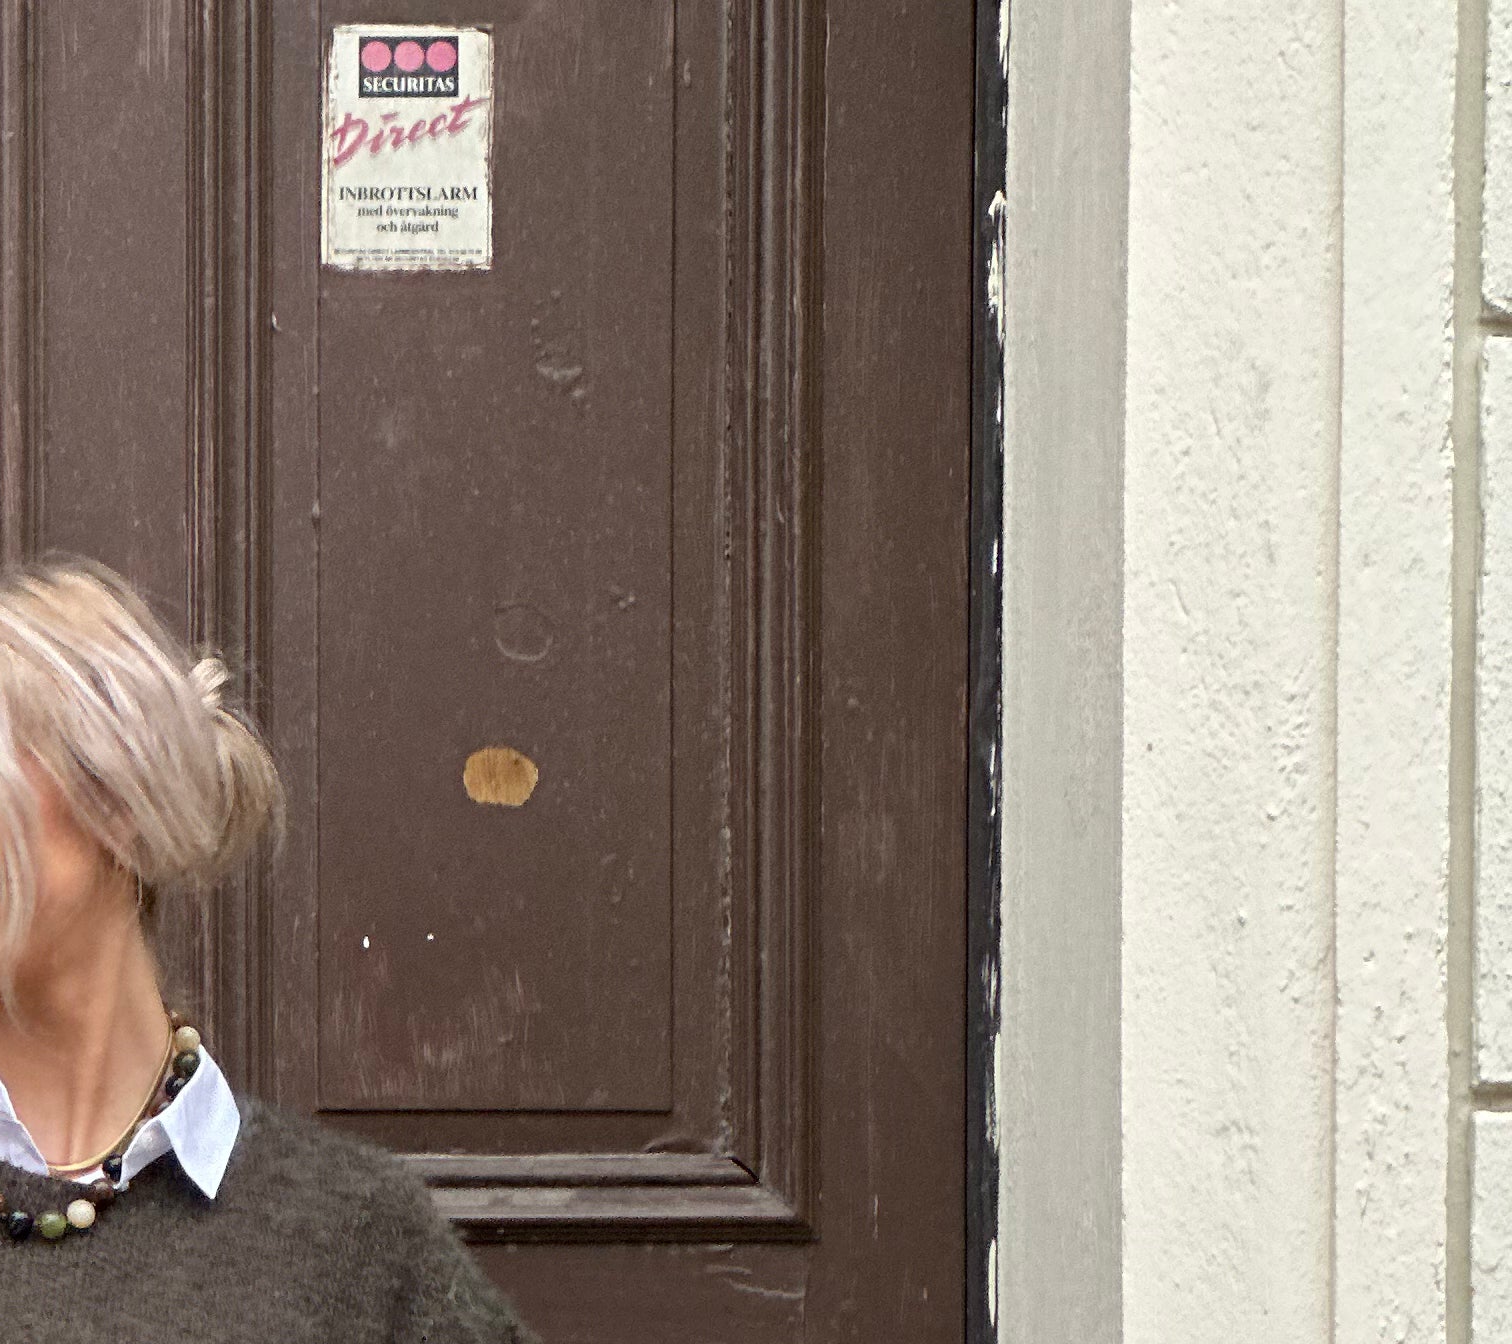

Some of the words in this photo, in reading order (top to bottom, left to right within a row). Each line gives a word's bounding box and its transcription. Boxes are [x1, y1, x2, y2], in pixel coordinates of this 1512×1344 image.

[363, 76, 455, 92] SECURITAS
[330, 94, 488, 166] Direct
[339, 186, 478, 200] INBROTTSLARM
[357, 205, 383, 217] med
[385, 204, 459, 219] övervakning
[376, 220, 398, 232] och
[400, 220, 439, 234] åtgärd
